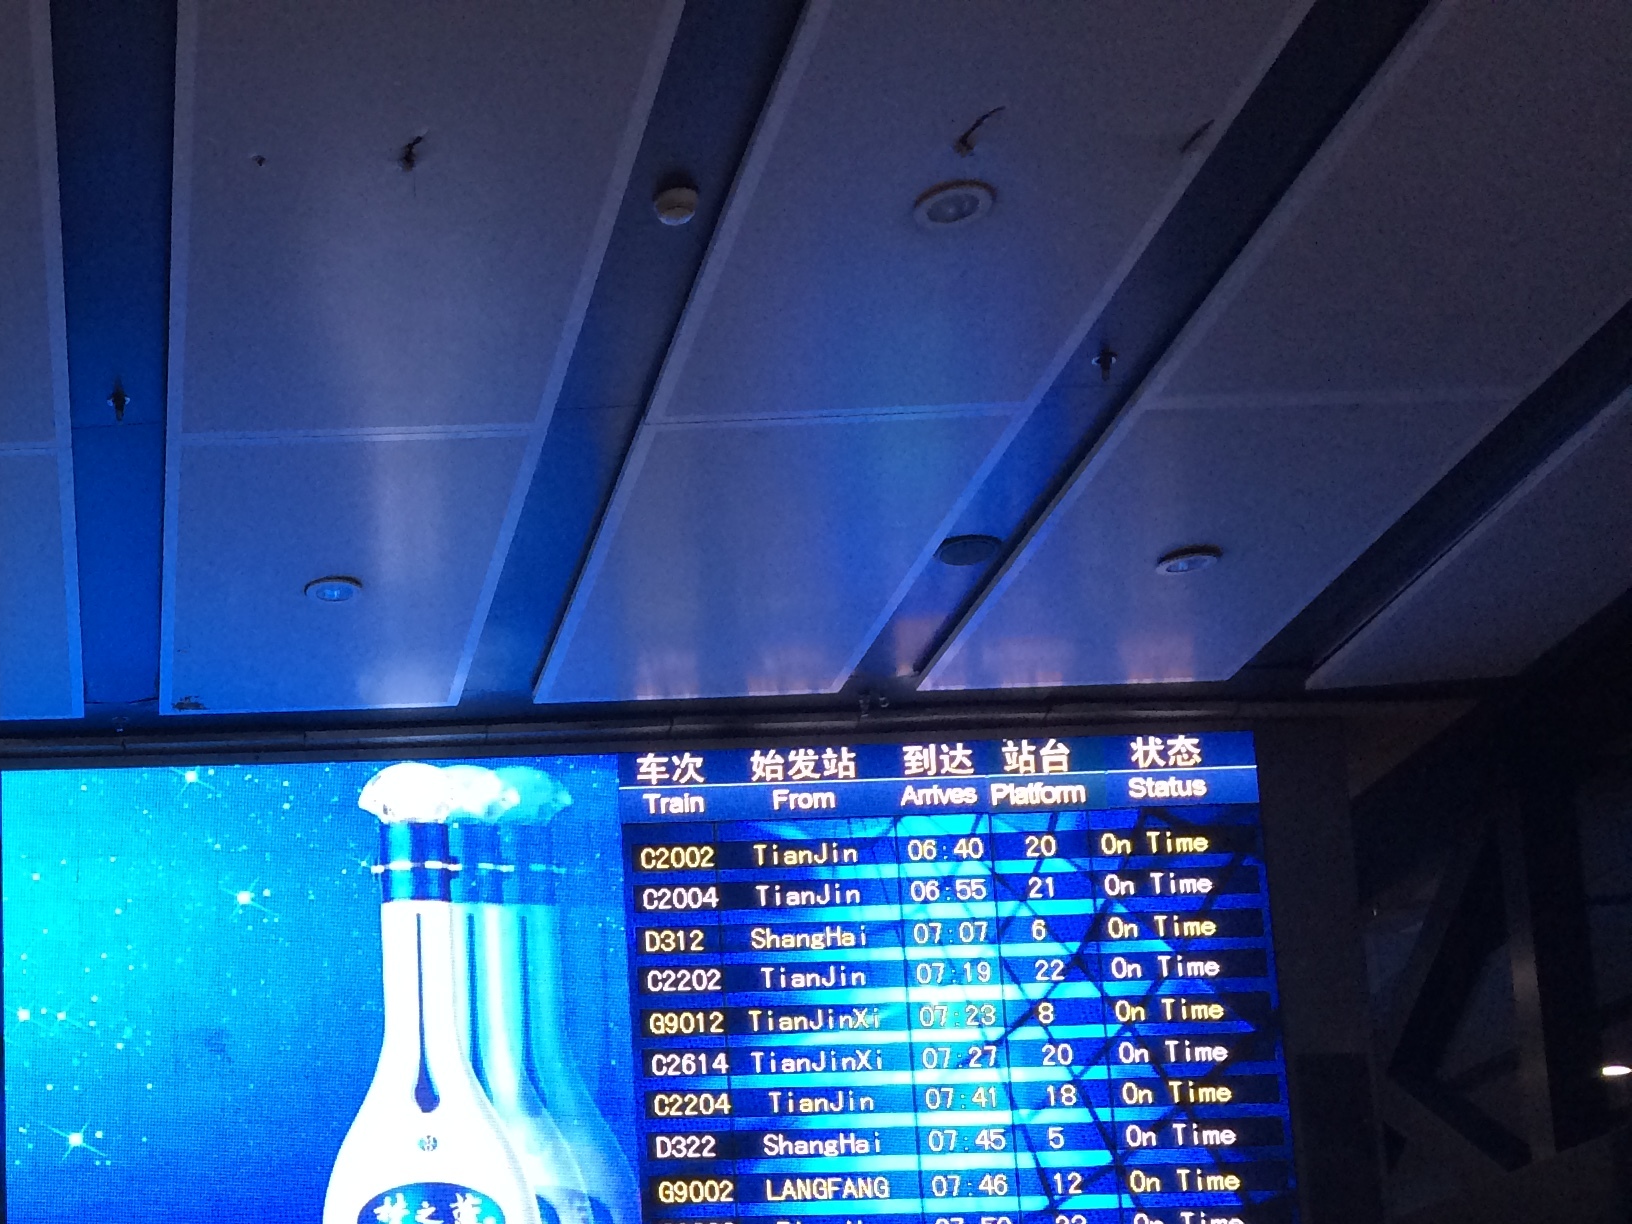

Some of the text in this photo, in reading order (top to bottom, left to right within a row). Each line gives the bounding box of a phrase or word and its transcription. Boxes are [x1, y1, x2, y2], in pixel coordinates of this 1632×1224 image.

[636, 737, 1202, 783] 车次 始发站 到达 站台 状态
[643, 777, 1206, 814] Train From Arrives Platform Status
[641, 832, 1208, 868] C2002 TianJin 06:40 20 On Time
[643, 874, 1212, 910] C2004 TianJin 06:55 21 On Time
[645, 916, 1216, 952] D312 ShangHai 6 On Time
[647, 957, 1220, 992] C2202 TianJin 22 On Time
[650, 1000, 1223, 1034] G9012 TianJinXi 8 On Time
[651, 1042, 1228, 1076] C2614 TianJinXi 20 On Time
[654, 1082, 1232, 1116] C2204 TianJin 18 On Time
[656, 1124, 1236, 1158] D322 ShangHai 5 On Time
[659, 1171, 1240, 1203] G9002 LANGFANG 12 On Time
